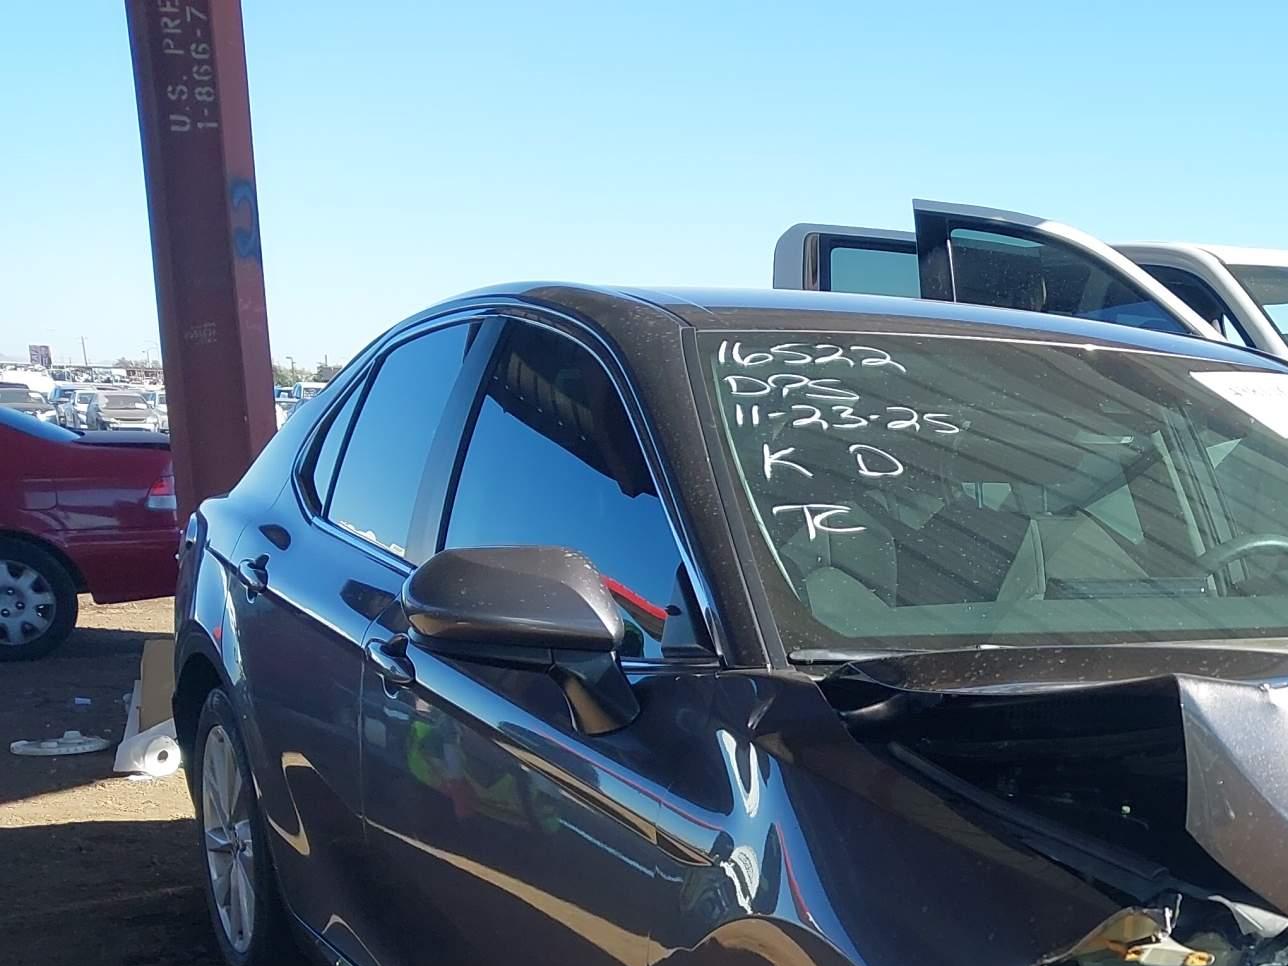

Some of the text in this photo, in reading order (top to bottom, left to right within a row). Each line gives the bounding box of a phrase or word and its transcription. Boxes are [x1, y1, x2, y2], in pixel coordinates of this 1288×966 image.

[185, 6, 218, 129] 1-866-7
[167, 75, 191, 132] U.S.
[723, 374, 860, 400] DPS
[763, 443, 904, 480] K D
